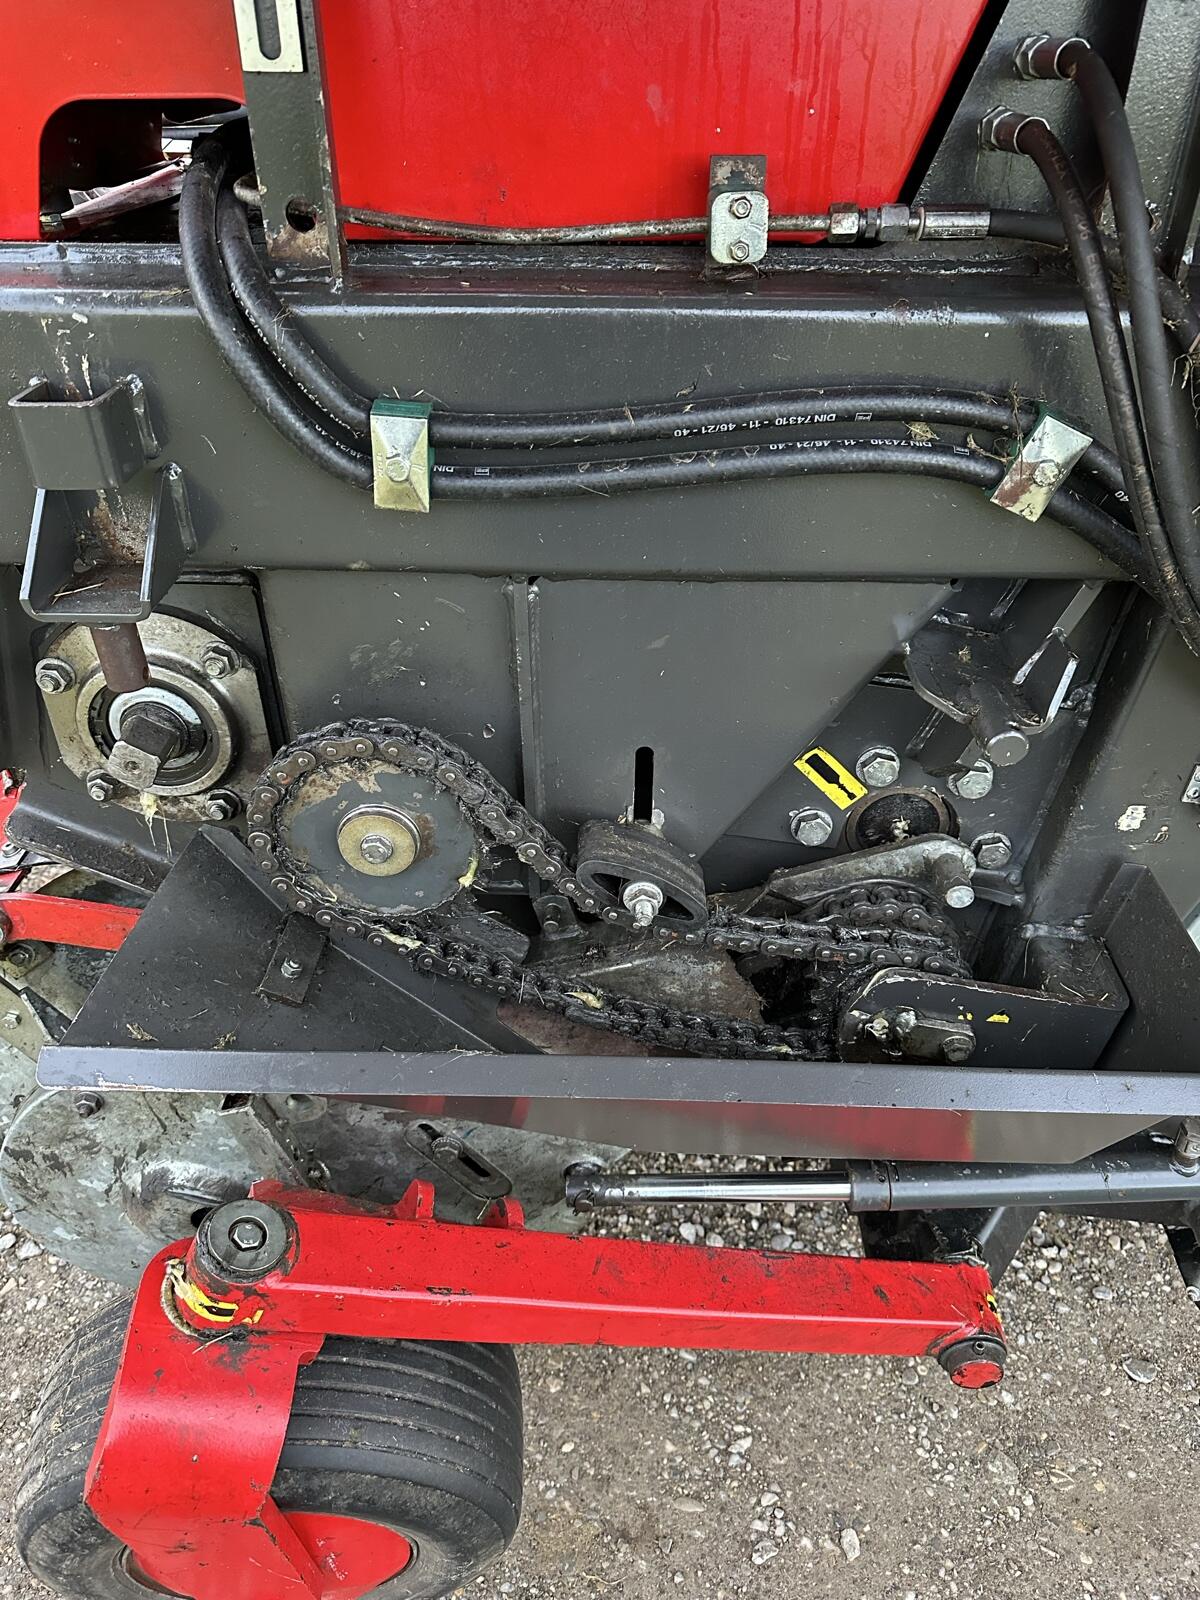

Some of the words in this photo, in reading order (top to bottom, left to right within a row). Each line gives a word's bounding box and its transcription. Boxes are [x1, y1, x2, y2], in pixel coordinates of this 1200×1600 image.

[775, 415, 811, 426] 74310
[814, 414, 836, 423] DIN
[673, 428, 690, 437] 40
[701, 423, 737, 434] 46/21
[910, 440, 933, 448] DIN
[433, 465, 455, 473] DIN
[1114, 490, 1130, 502] 40
